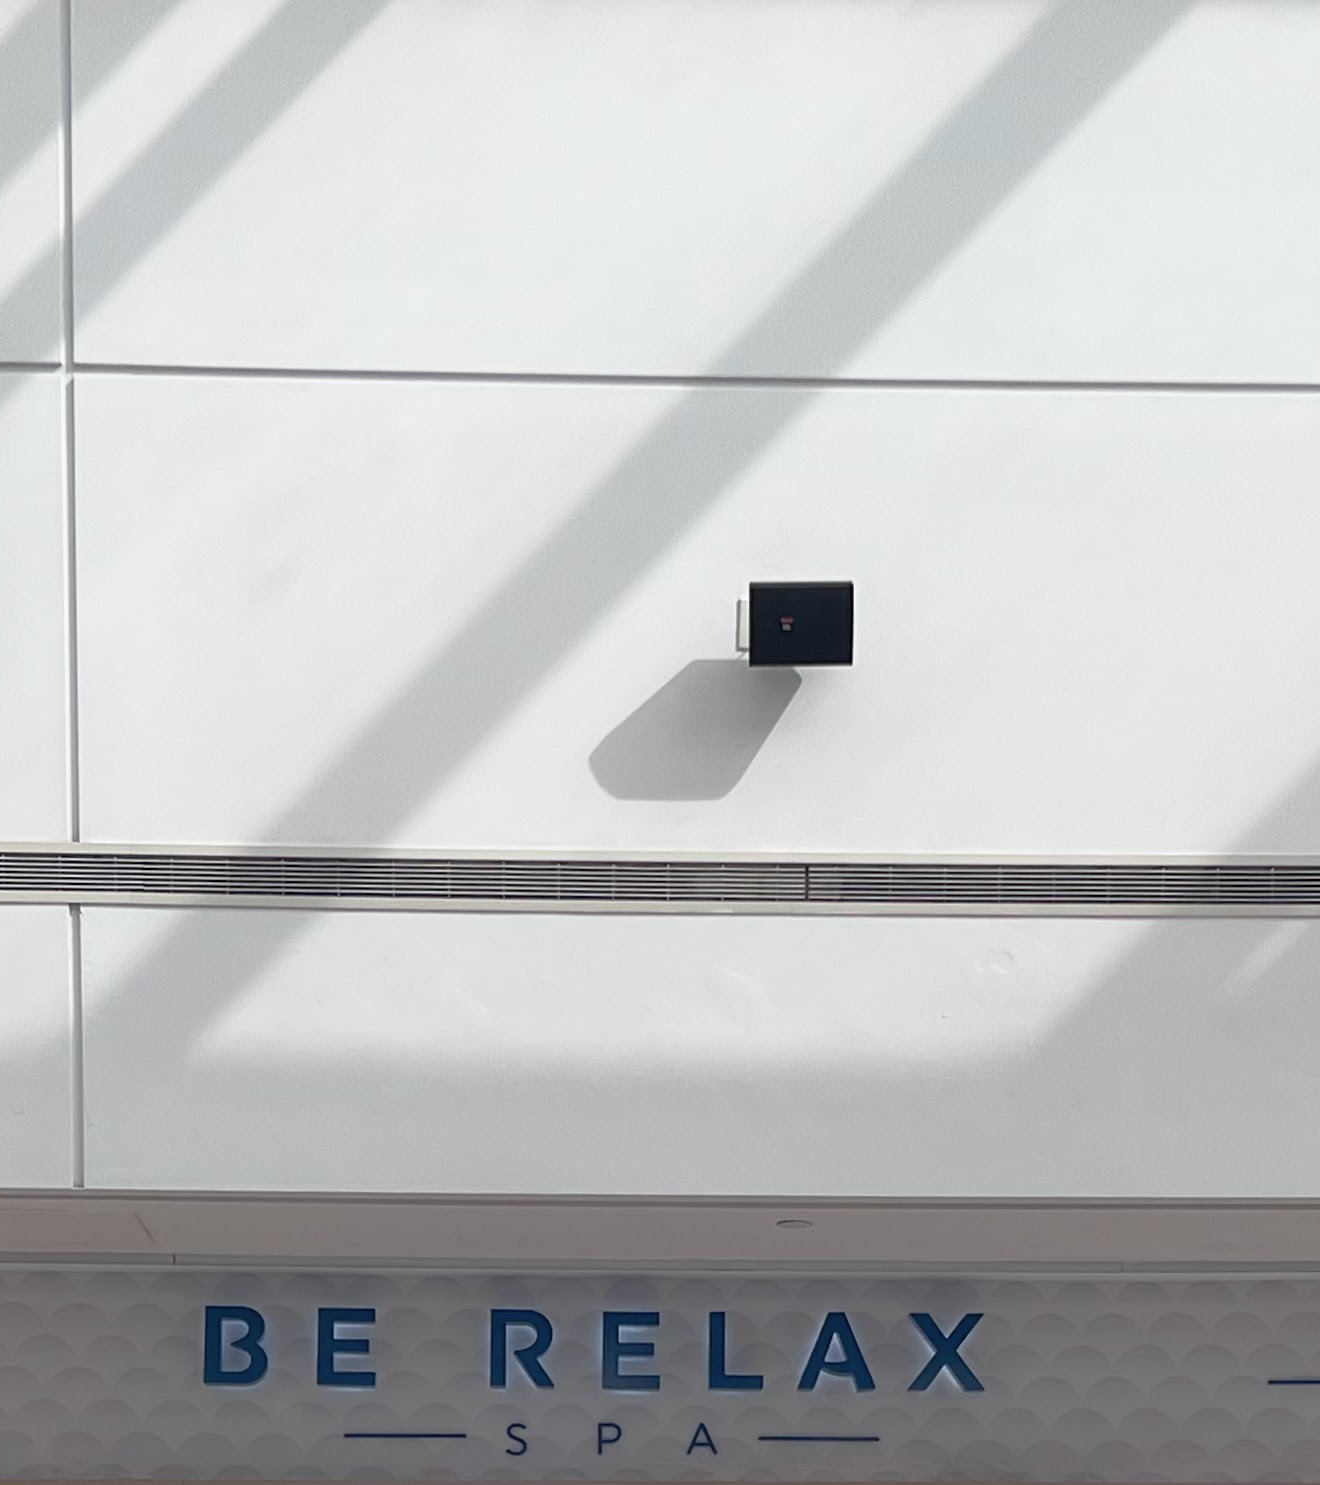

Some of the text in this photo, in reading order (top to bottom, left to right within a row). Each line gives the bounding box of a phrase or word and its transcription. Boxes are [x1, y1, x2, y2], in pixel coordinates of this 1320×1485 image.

[203, 1305, 986, 1393] BE RELAX
[505, 1422, 719, 1457] SPA
